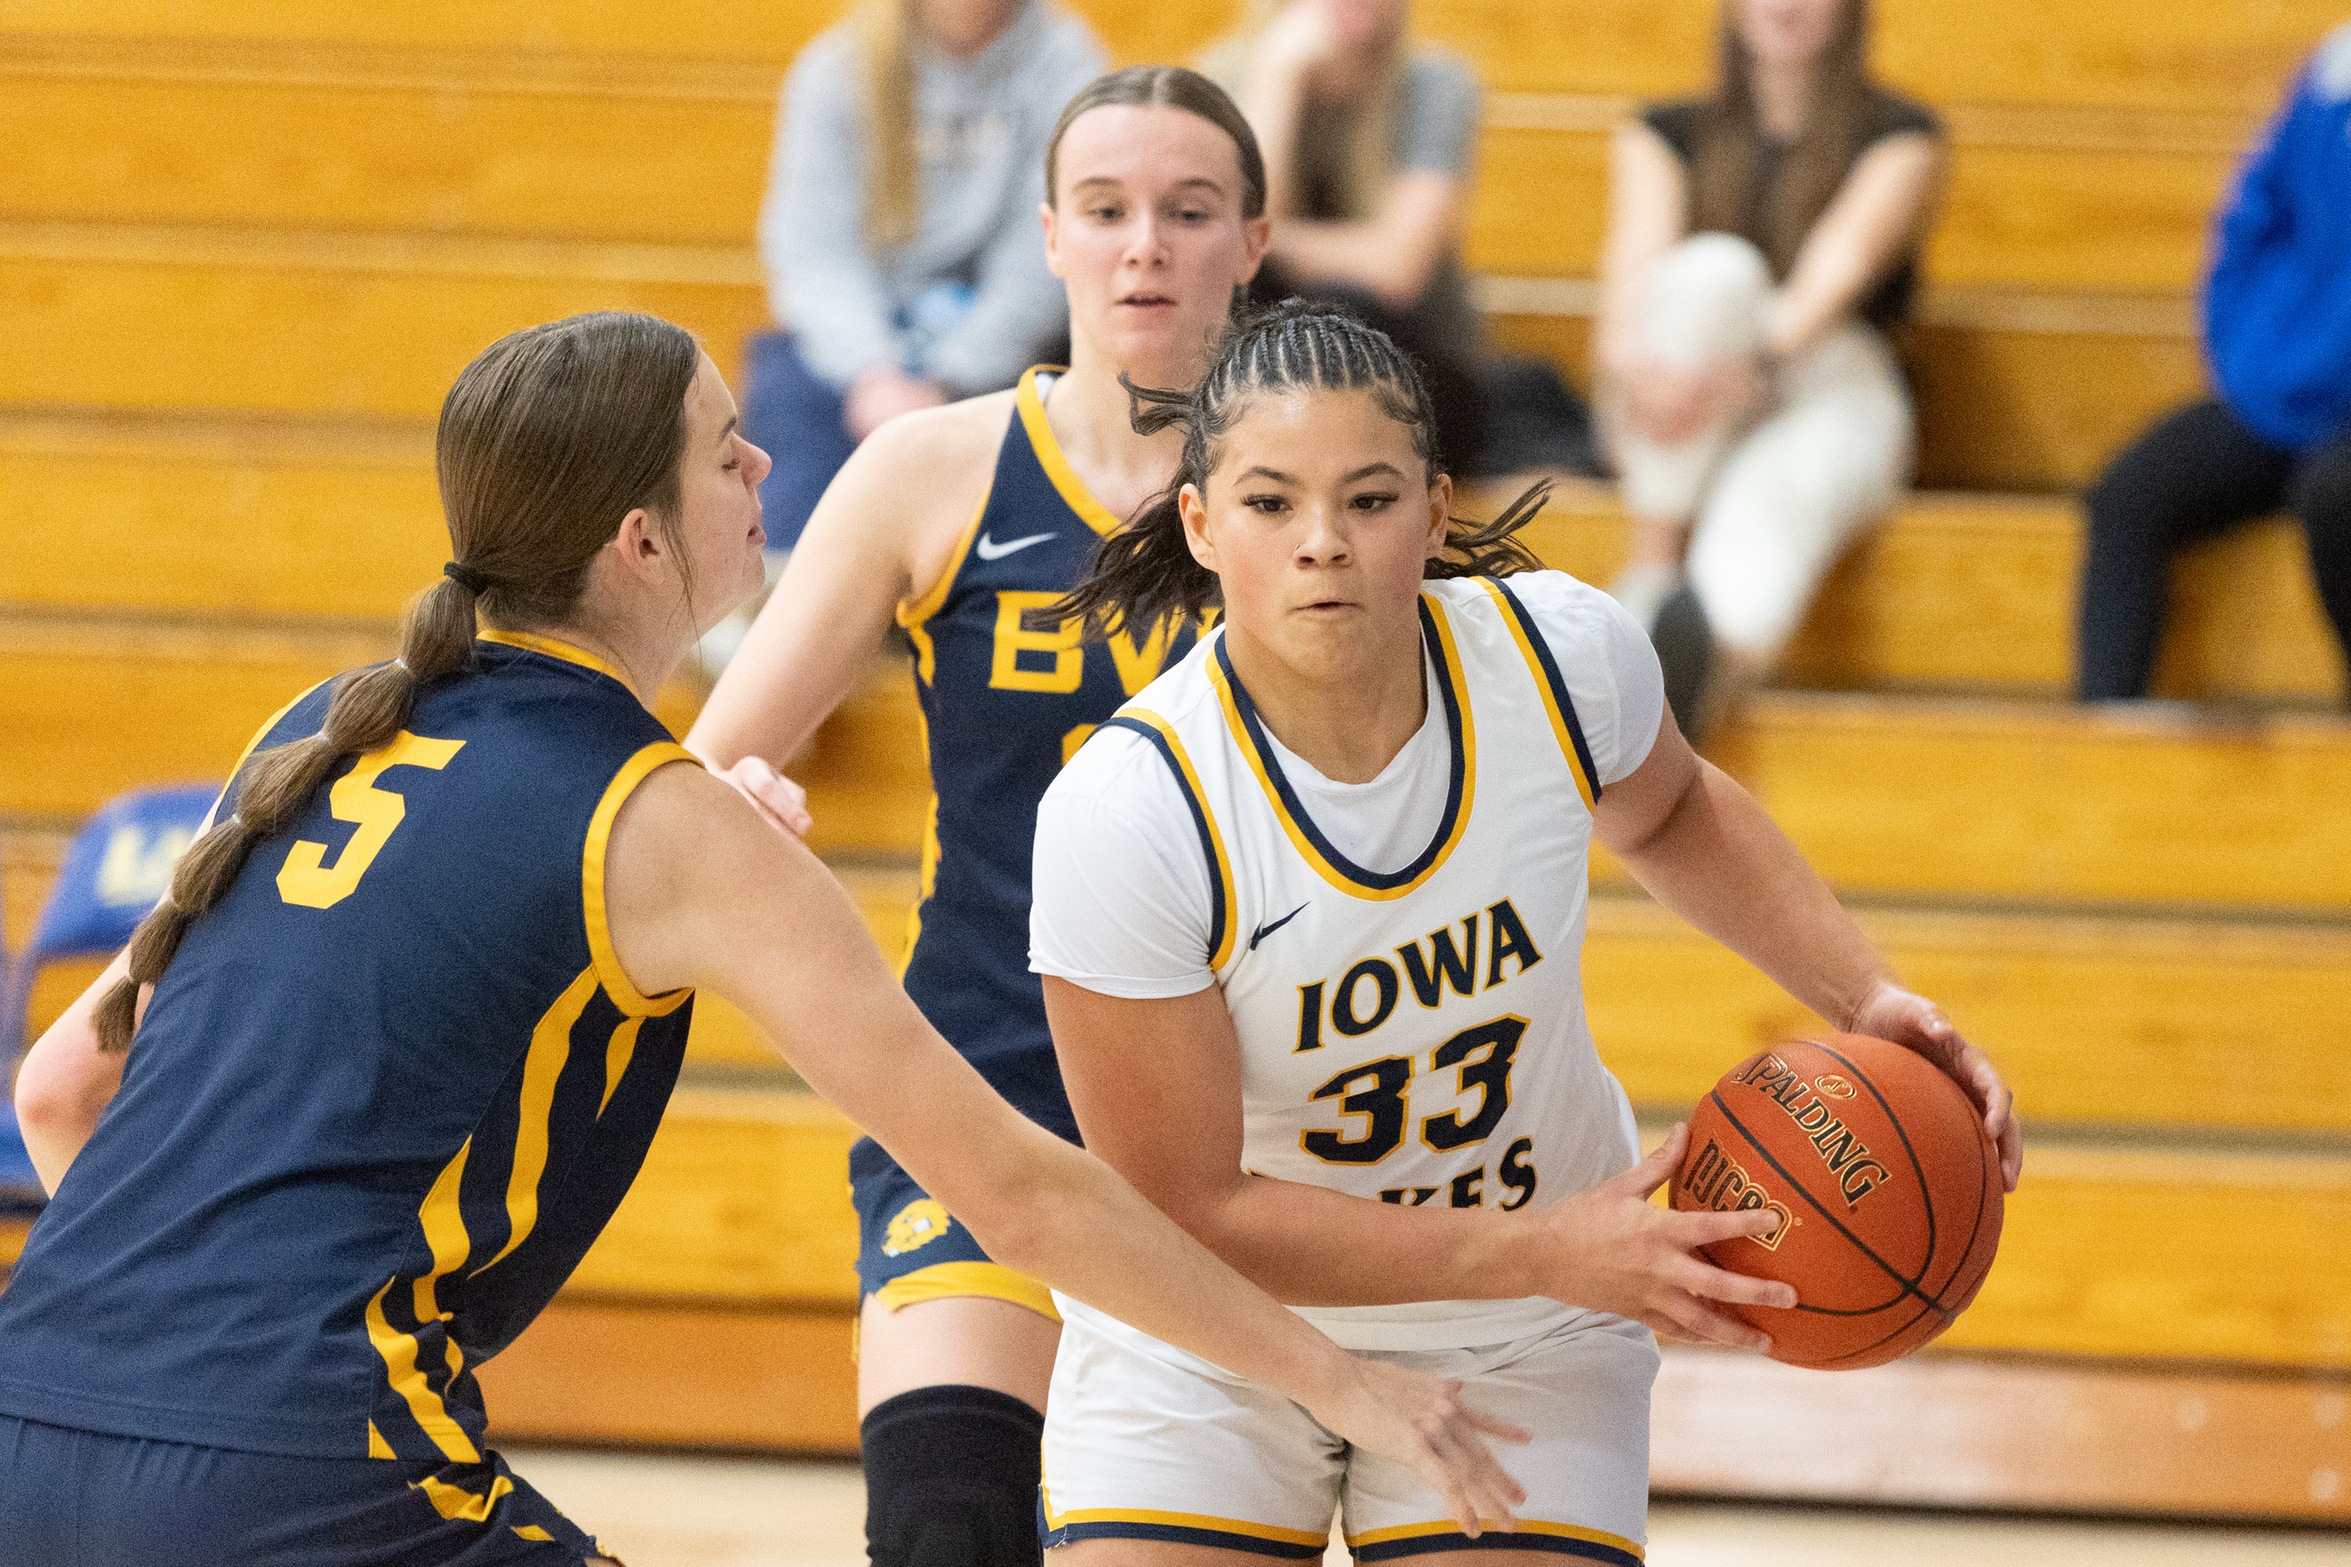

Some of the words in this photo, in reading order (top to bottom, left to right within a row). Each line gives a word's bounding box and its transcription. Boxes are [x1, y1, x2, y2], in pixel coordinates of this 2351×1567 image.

[987, 590, 1224, 697] BV
[275, 729, 468, 910] 5
[1292, 897, 1544, 1054] IOWA
[1300, 1013, 1532, 1166] 33
[1731, 1053, 1892, 1209] SPALDING
